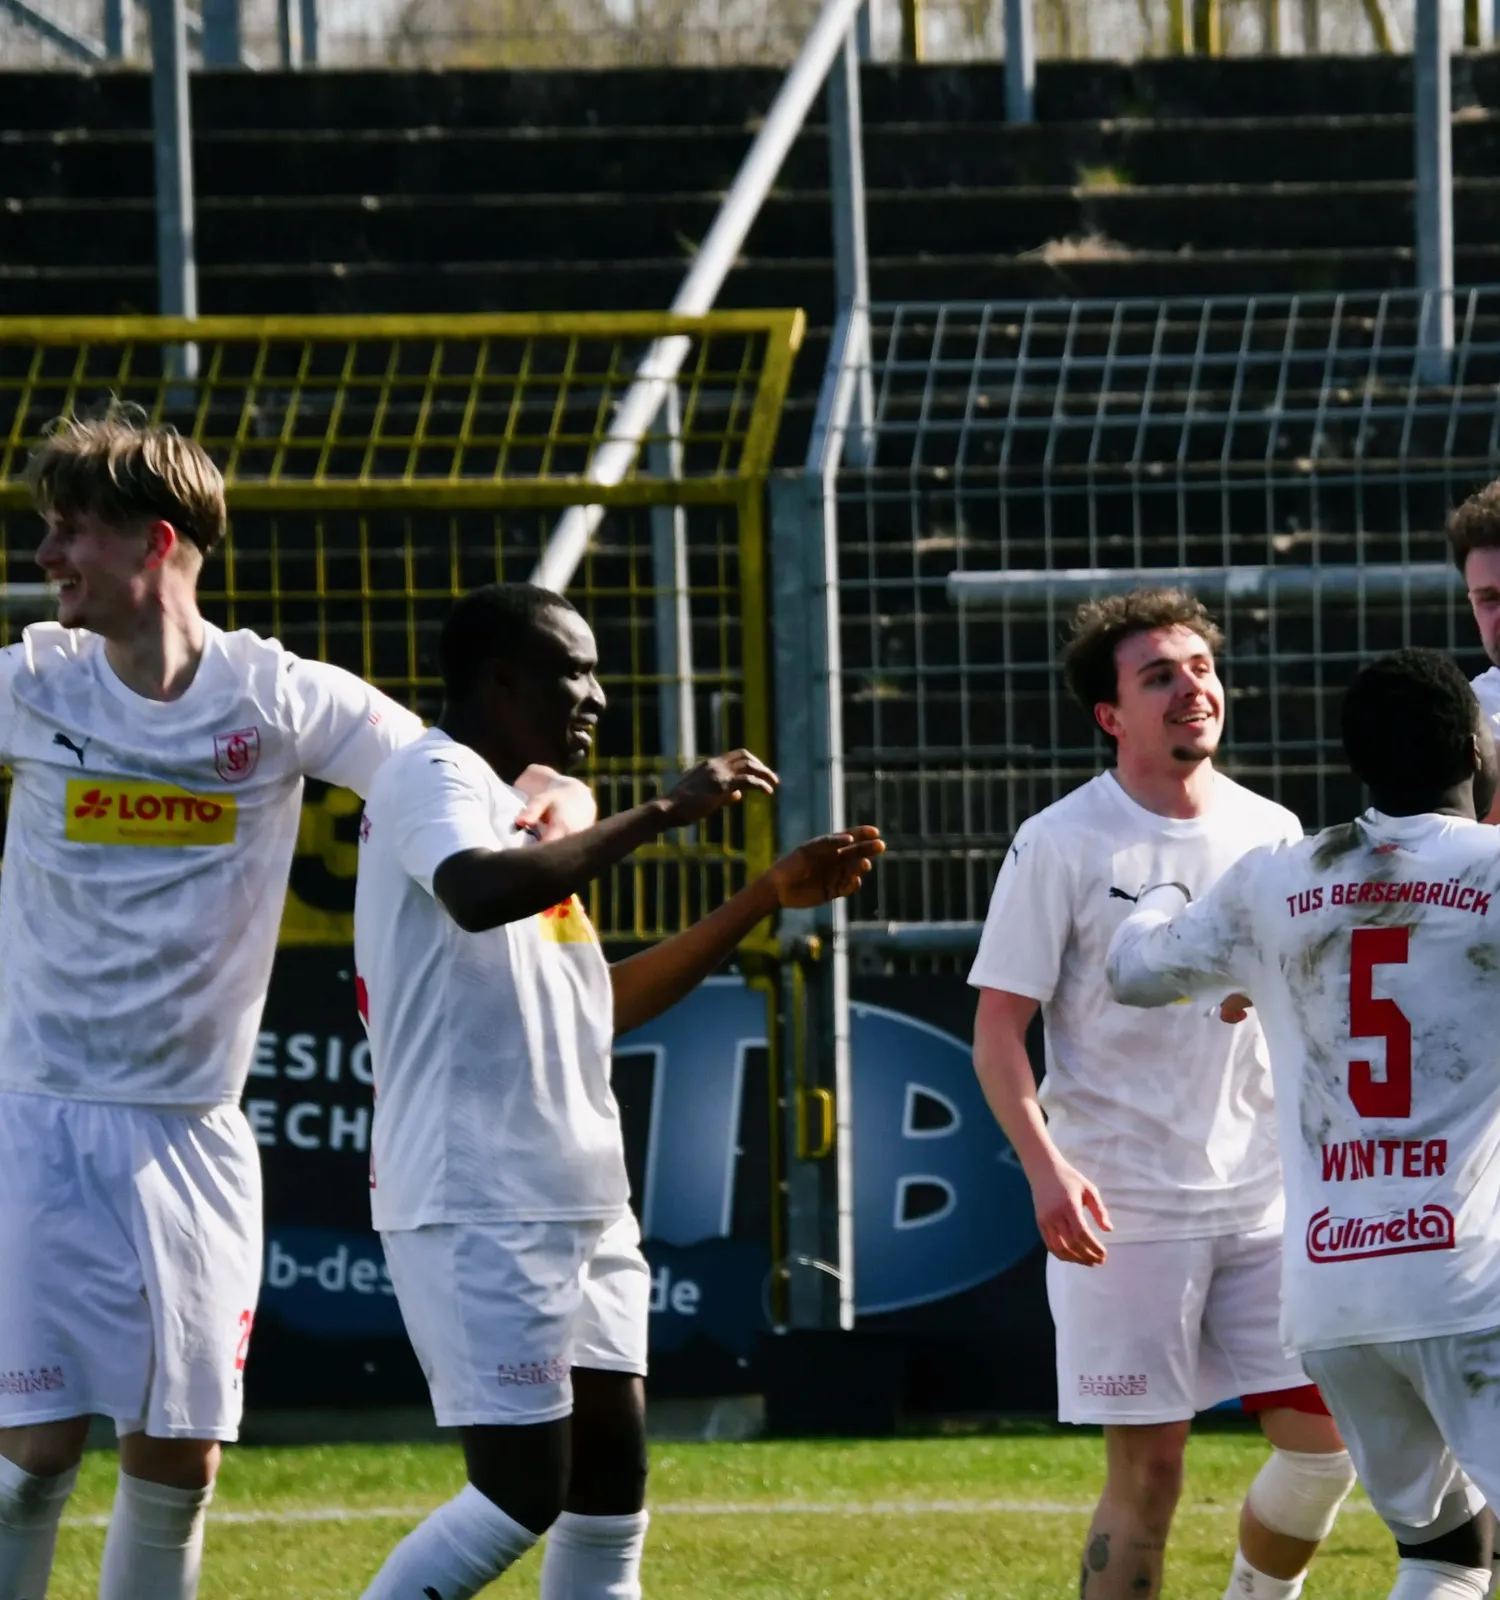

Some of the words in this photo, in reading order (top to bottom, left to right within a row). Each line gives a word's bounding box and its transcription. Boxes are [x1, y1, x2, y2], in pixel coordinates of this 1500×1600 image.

[118, 794, 223, 823] LOTTO
[1286, 886, 1324, 918] TUS
[1330, 878, 1492, 917] BERSENBRÜCK
[1347, 926, 1412, 1119] 5
[1321, 1139, 1447, 1183] WINTER
[1308, 1206, 1450, 1257] Culimeta
[1079, 1381, 1148, 1397] PRINZ
